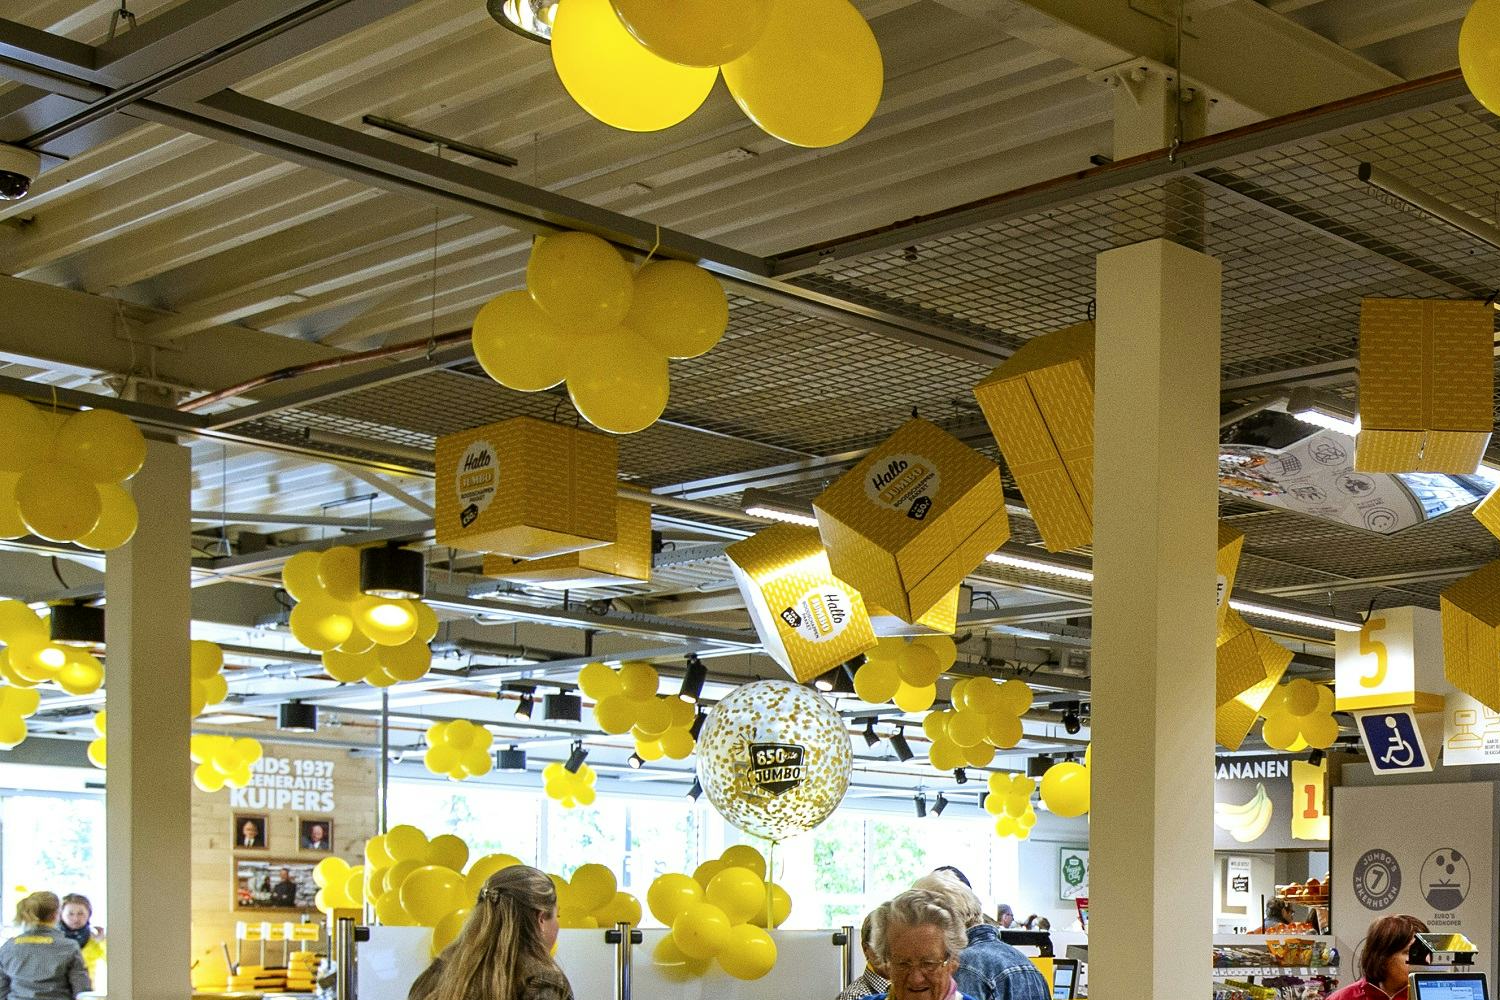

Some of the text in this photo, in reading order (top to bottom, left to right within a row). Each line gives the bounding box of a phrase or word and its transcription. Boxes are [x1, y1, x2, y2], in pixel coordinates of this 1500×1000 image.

[464, 450, 491, 472] Hallo
[872, 460, 908, 491] Hallo
[824, 594, 846, 623] Hallo
[1360, 618, 1388, 689] 5
[293, 760, 335, 778] 1937
[754, 767, 800, 783] JUMBO
[1215, 760, 1289, 780] ANANEN
[252, 773, 334, 791] ENERATIES
[229, 787, 336, 813] KUIPERS
[1303, 784, 1318, 819] 1
[1363, 853, 1398, 873] JUMBO'S
[1371, 869, 1384, 889] 7
[1355, 877, 1398, 908] ZEKERHEDEN
